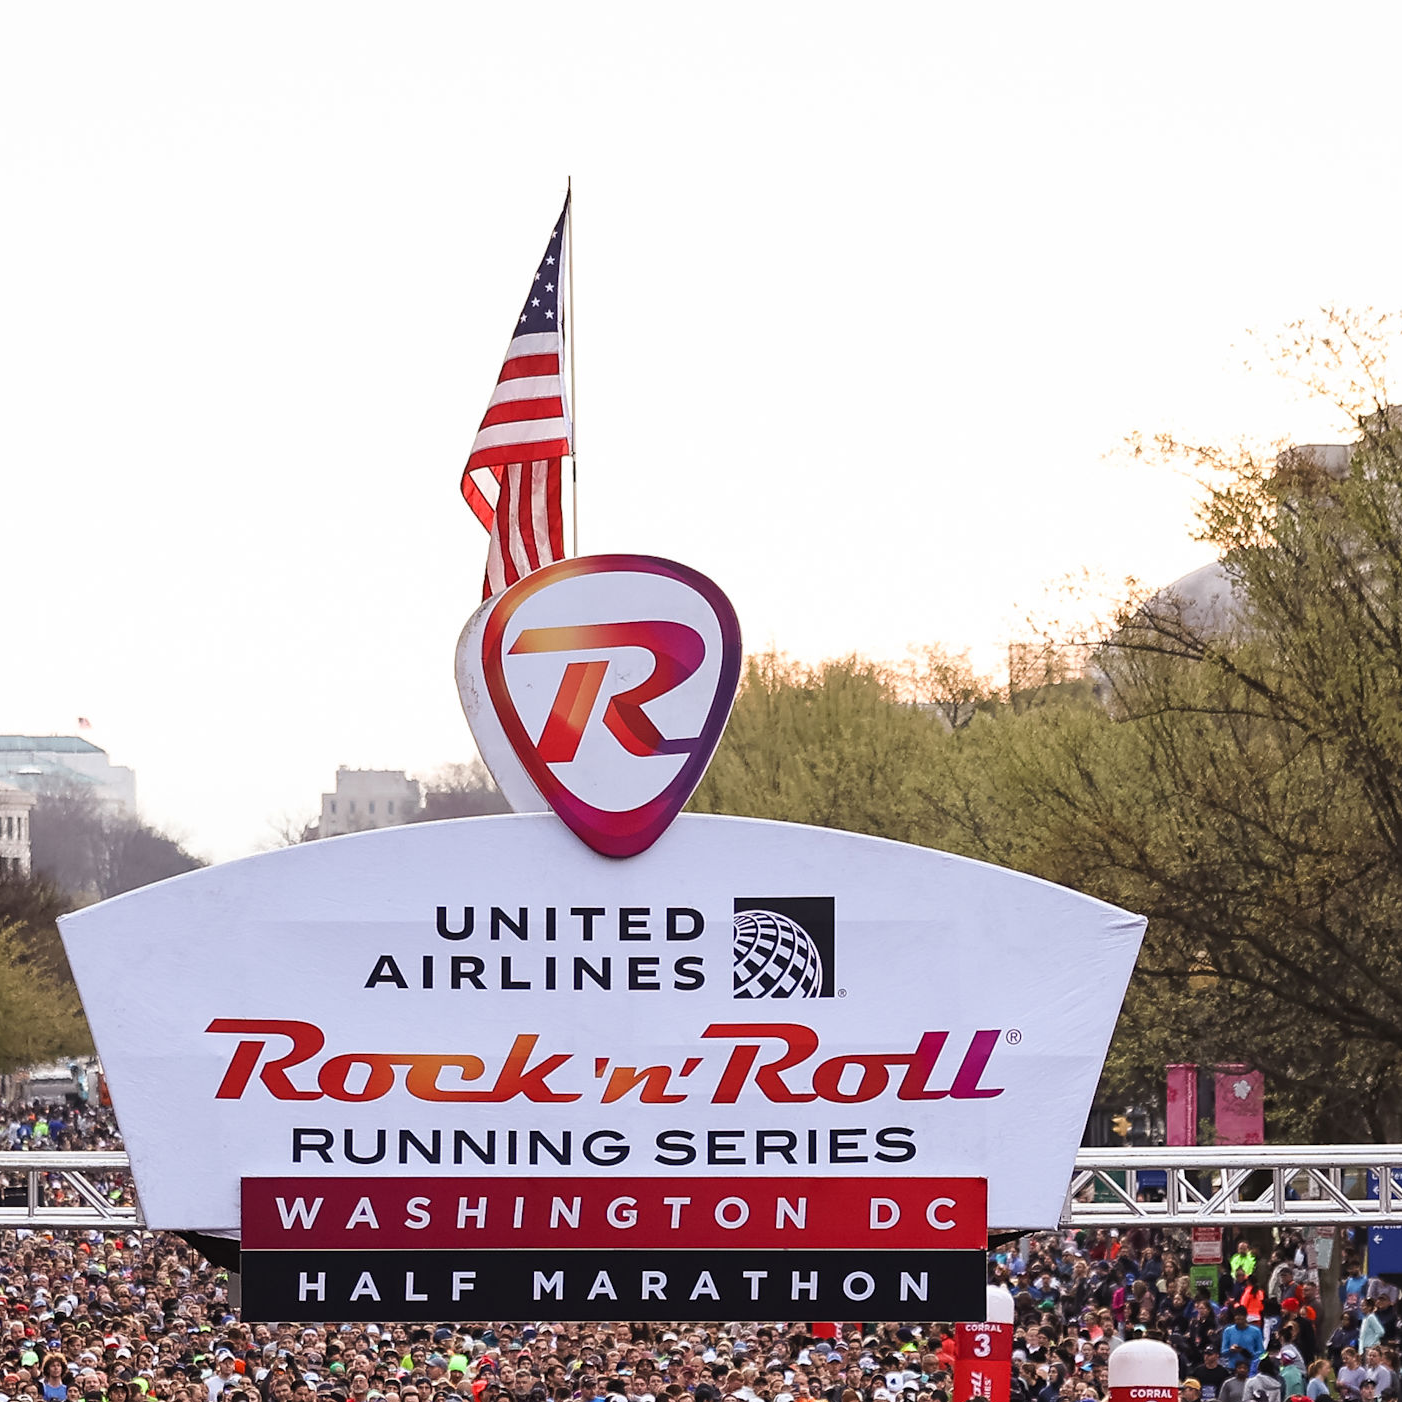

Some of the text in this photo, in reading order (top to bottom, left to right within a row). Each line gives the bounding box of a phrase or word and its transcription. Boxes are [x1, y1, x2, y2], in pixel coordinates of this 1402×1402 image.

[436, 906, 705, 942] UNITED
[365, 954, 705, 991] AIRLINES
[292, 1126, 918, 1167] RUNNING SERIES
[276, 1195, 958, 1231] WASHINGTON DC
[298, 1270, 930, 1303] HALF MARATHON
[964, 1323, 1002, 1333] CORRAL
[973, 1333, 991, 1358] 3
[1129, 1389, 1173, 1399] CORRAL
